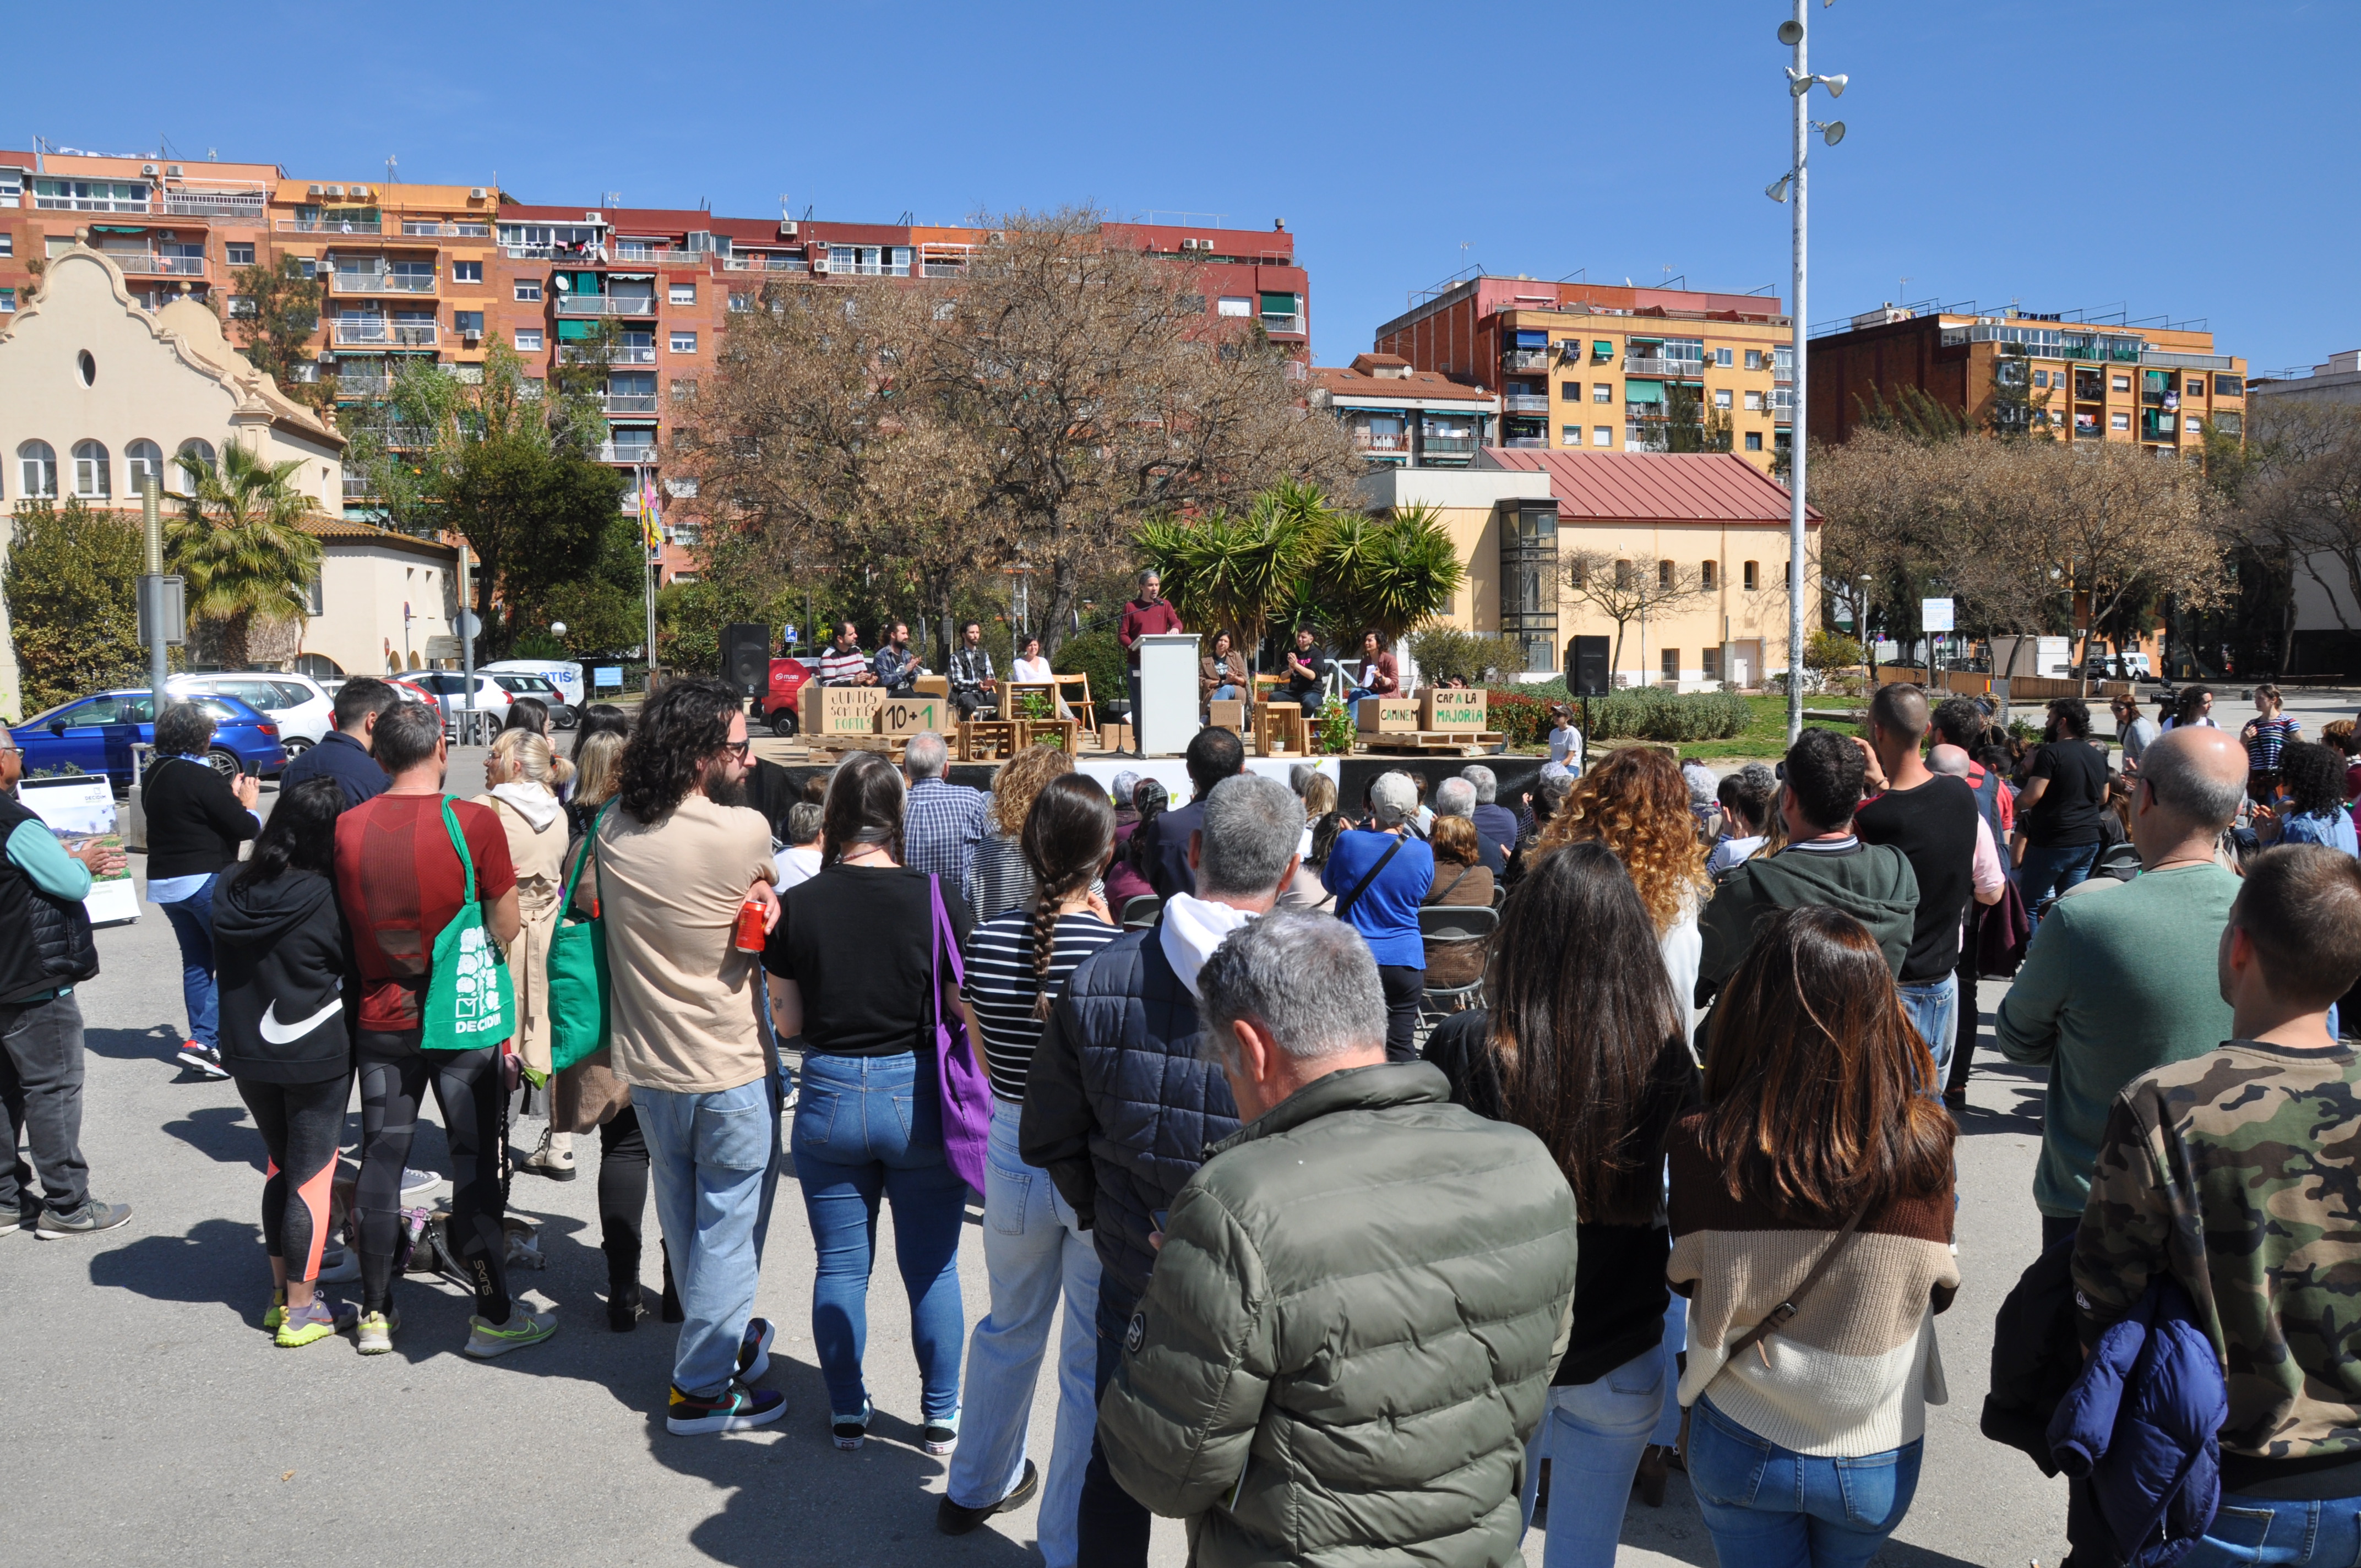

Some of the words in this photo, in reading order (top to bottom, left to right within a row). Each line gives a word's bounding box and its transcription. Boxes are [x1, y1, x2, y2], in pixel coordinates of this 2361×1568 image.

[831, 690, 877, 705] JUNTES
[1437, 693, 1454, 704] CAP
[1455, 693, 1462, 704] A
[1465, 693, 1477, 704] LA
[830, 706, 851, 717] SOM
[856, 704, 877, 717] MÉS
[835, 717, 874, 730] FORTES
[473, 1260, 493, 1295] SKINS
